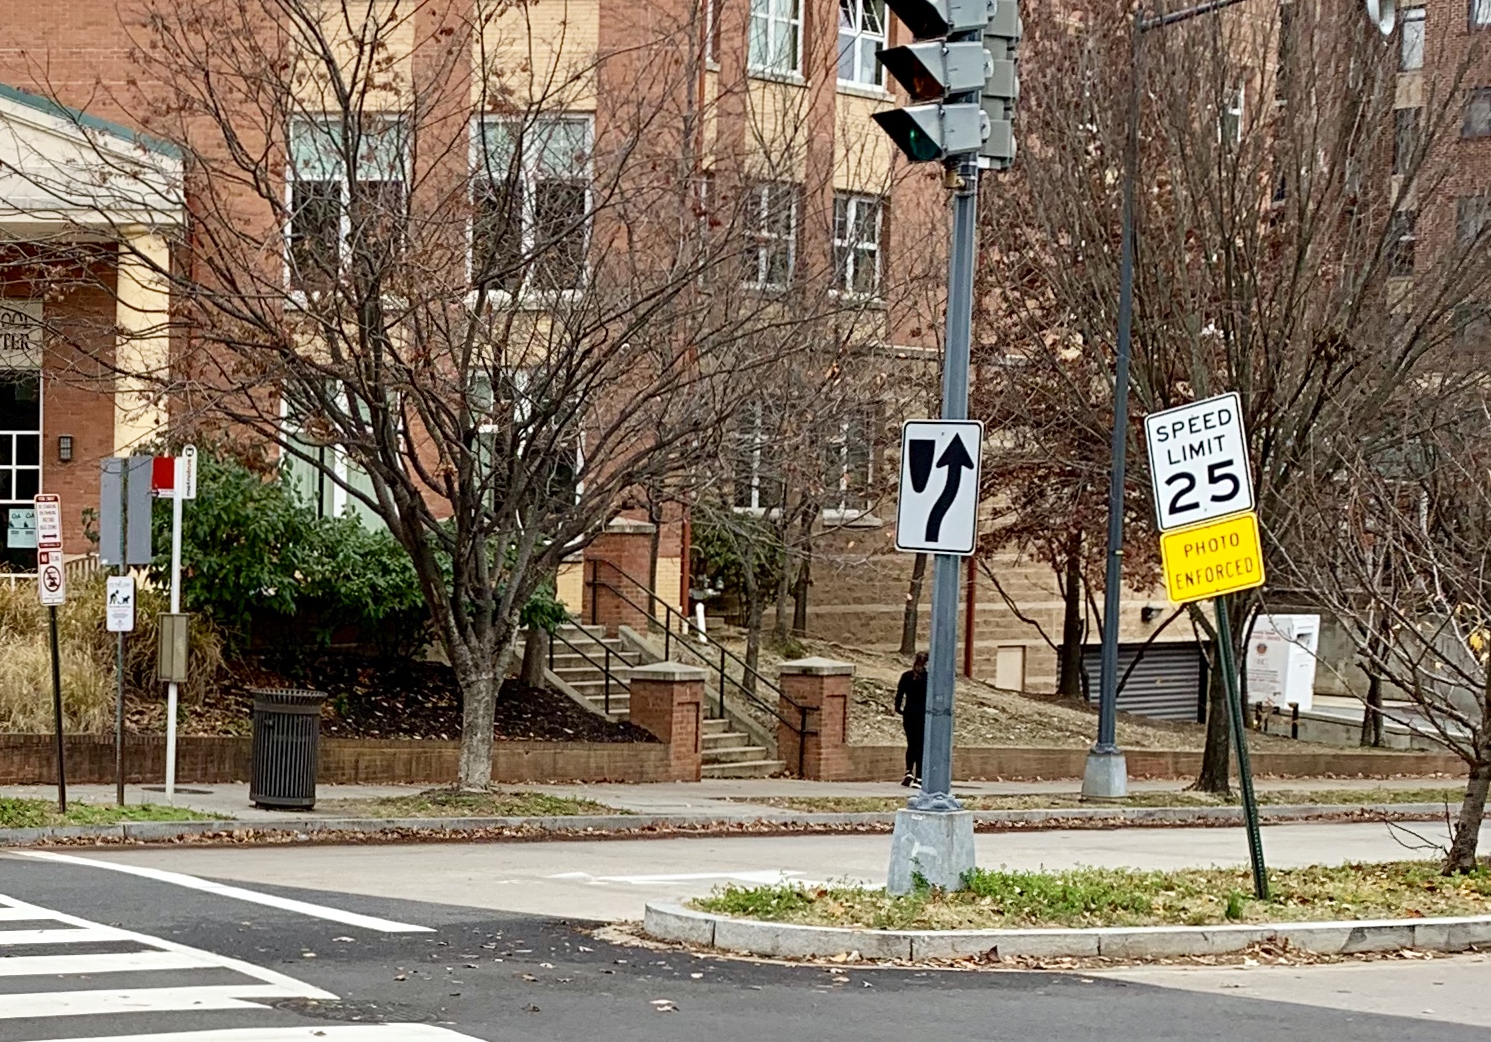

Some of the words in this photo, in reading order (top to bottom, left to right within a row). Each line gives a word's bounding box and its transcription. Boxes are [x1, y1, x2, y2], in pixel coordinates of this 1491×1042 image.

[1156, 408, 1232, 443] SPEED
[1167, 434, 1225, 465] LIMIT
[1164, 458, 1241, 516] 25
[1184, 532, 1240, 558] PHOTO
[1176, 557, 1254, 590] ENFORCED
